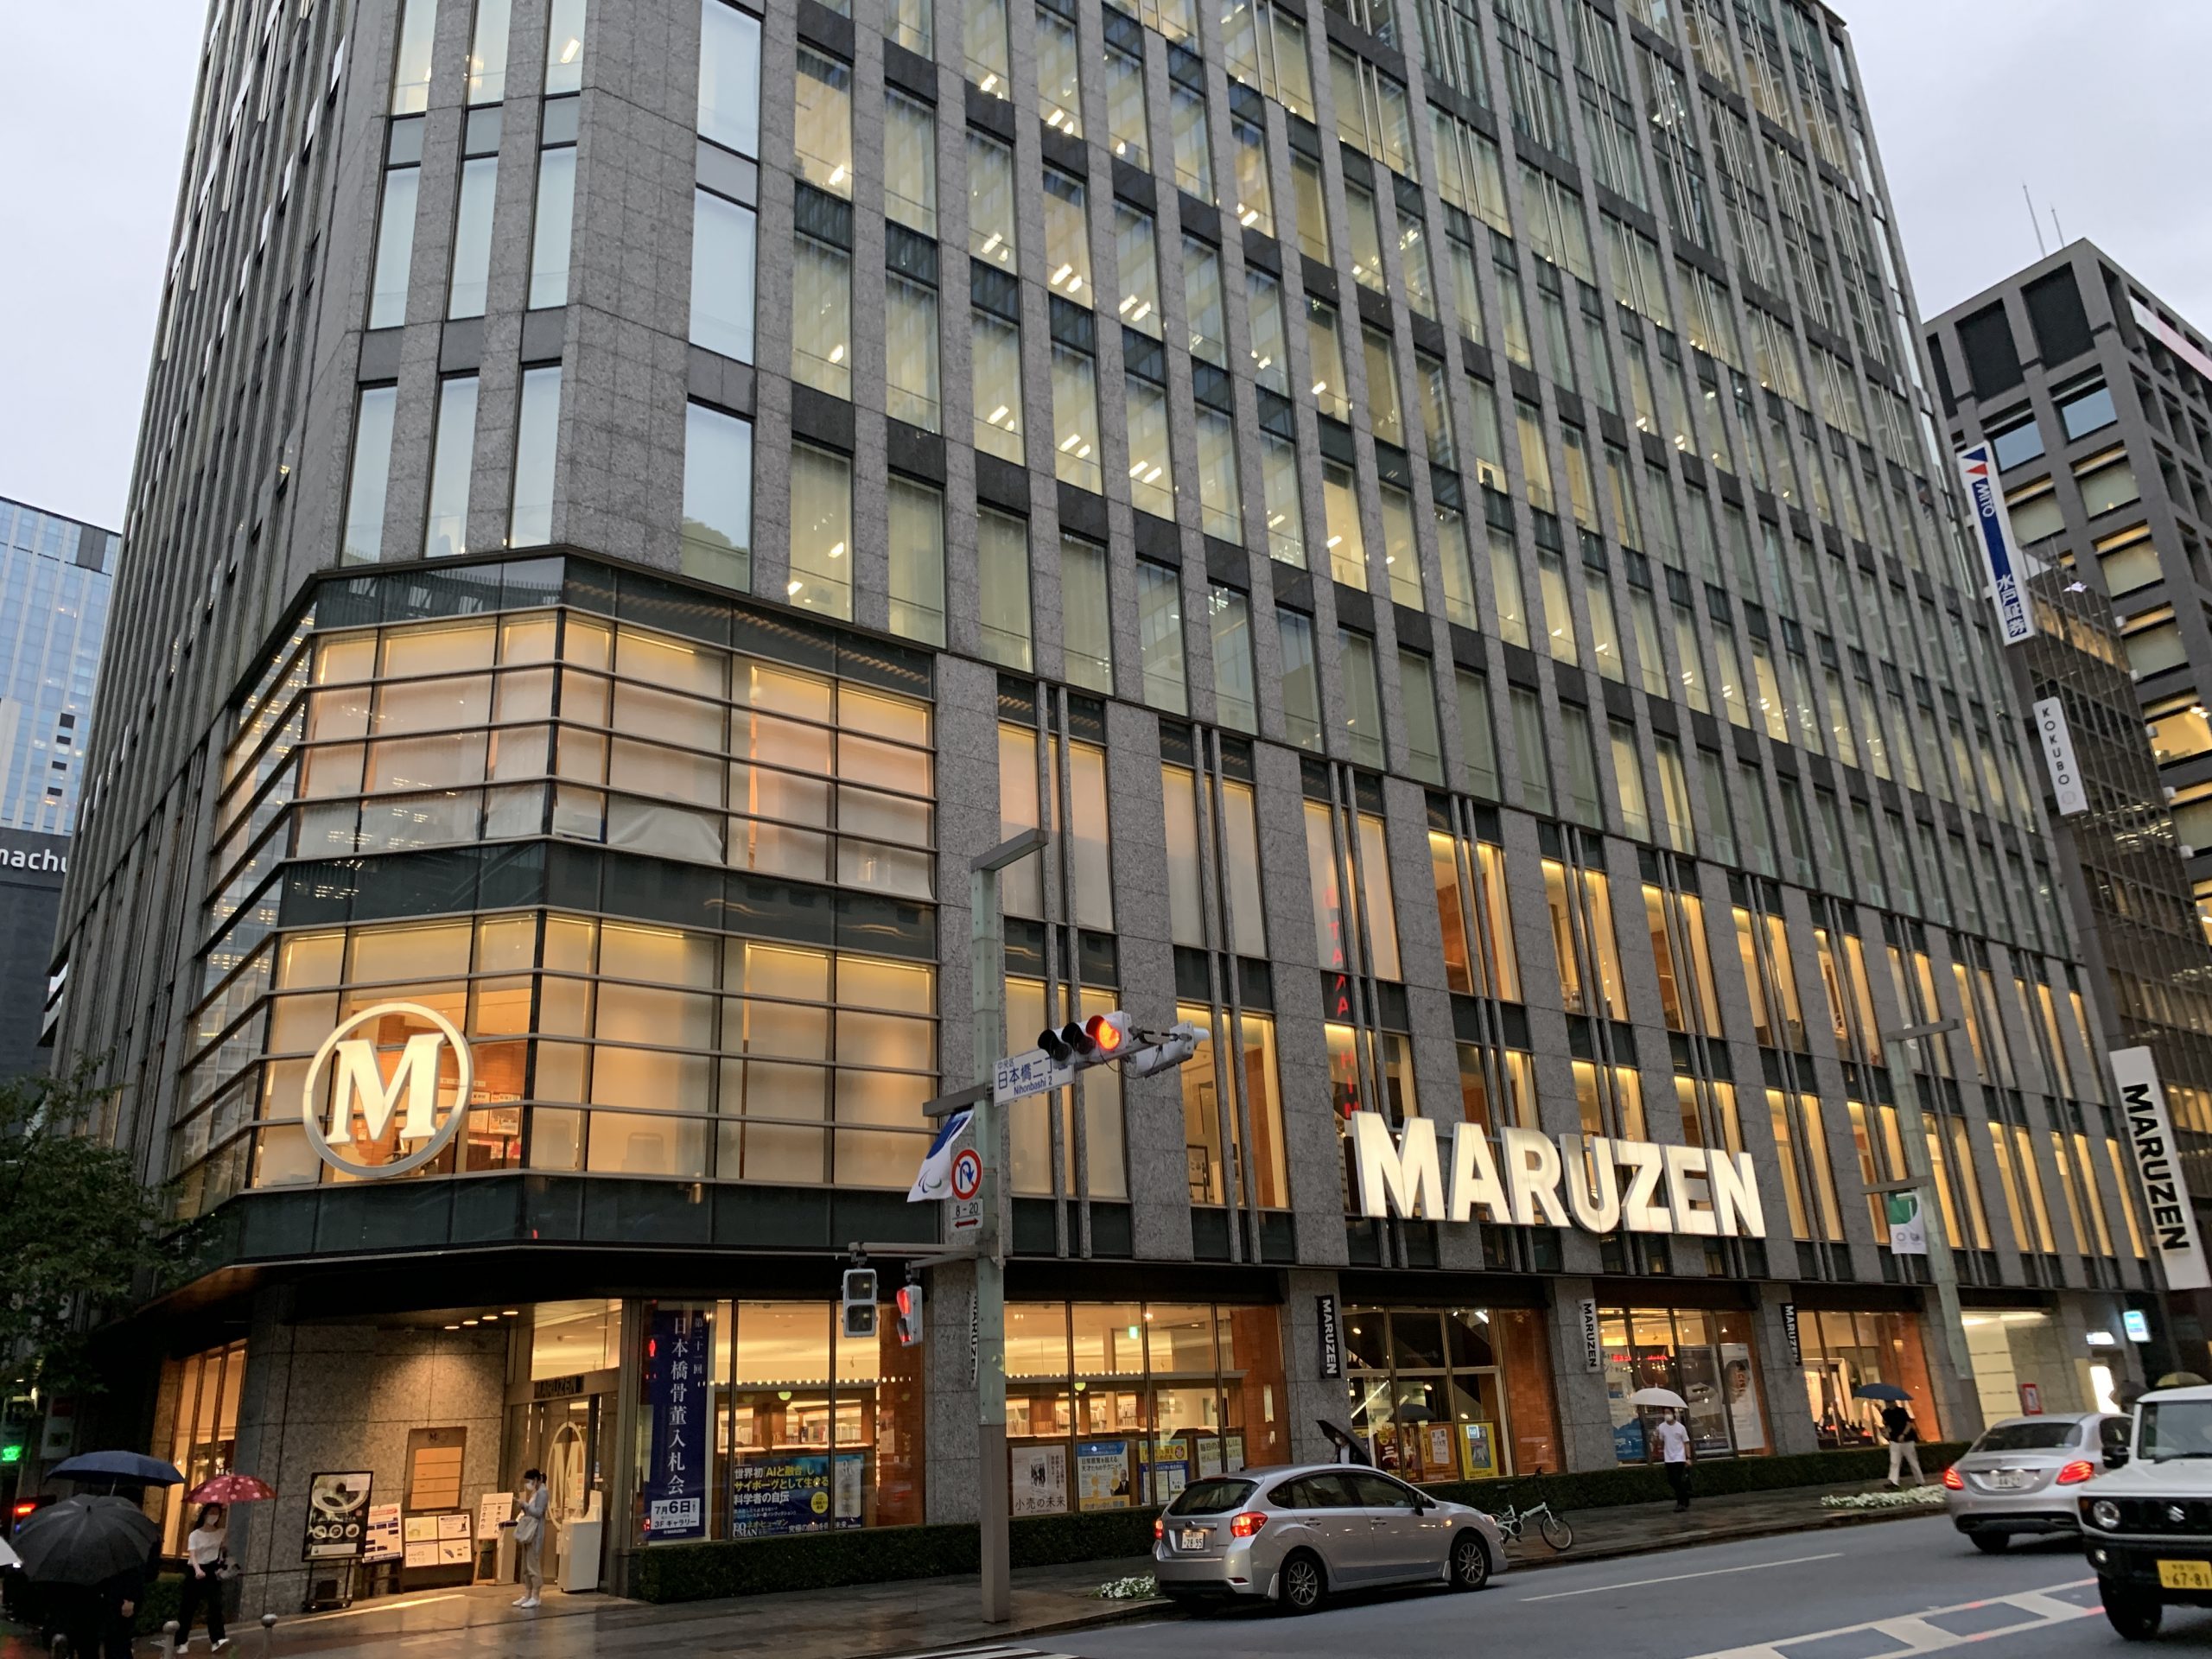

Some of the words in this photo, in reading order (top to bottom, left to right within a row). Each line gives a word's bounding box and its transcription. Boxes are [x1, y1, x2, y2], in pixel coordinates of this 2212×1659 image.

[1975, 483, 1996, 518] MITO
[2042, 707, 2070, 785] KOKUBO
[325, 1033, 445, 1145] M
[998, 1056, 1069, 1090] 日本橋二丁
[1014, 1077, 1046, 1096] Nihonbashi
[1048, 1075, 1052, 1085] 2
[1351, 1110, 1766, 1237] MARUZEN
[2121, 1083, 2191, 1251] MARUZEN
[1322, 1299, 1338, 1374] MARUZEN
[1583, 1302, 1598, 1367] MARUZEN
[668, 1317, 689, 1495] 日本橋骨董入札会
[734, 1476, 829, 1492] サイボーグとして生きる
[734, 1491, 790, 1506] 科学者の自伝
[654, 1500, 691, 1515] 7月6日
[1014, 1495, 1065, 1510] 小売の未来
[654, 1520, 664, 1529] 3F
[666, 1518, 696, 1528] ギャラリー
